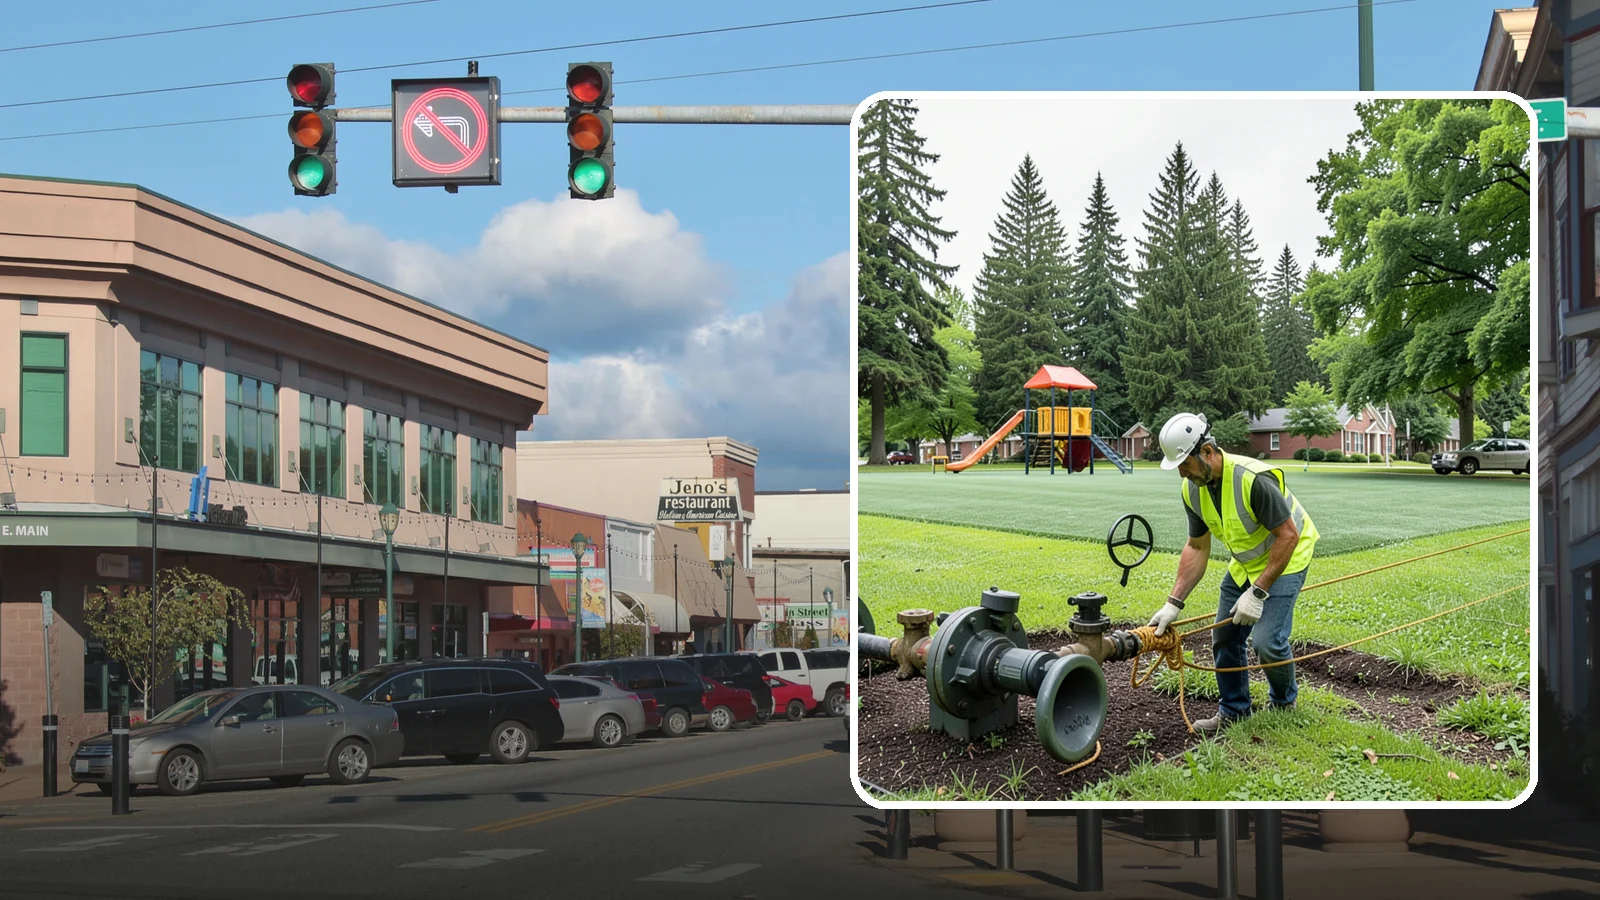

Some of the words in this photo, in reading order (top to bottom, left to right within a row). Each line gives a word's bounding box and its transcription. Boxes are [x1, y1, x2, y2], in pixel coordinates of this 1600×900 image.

[670, 480, 727, 494] Jeno's
[665, 497, 731, 509] restaurant
[659, 510, 681, 519] Italian
[686, 510, 714, 519] American
[715, 509, 738, 519] Cuisine
[2, 525, 13, 536] E.
[15, 525, 49, 536] MAIN
[798, 608, 828, 616] Street
